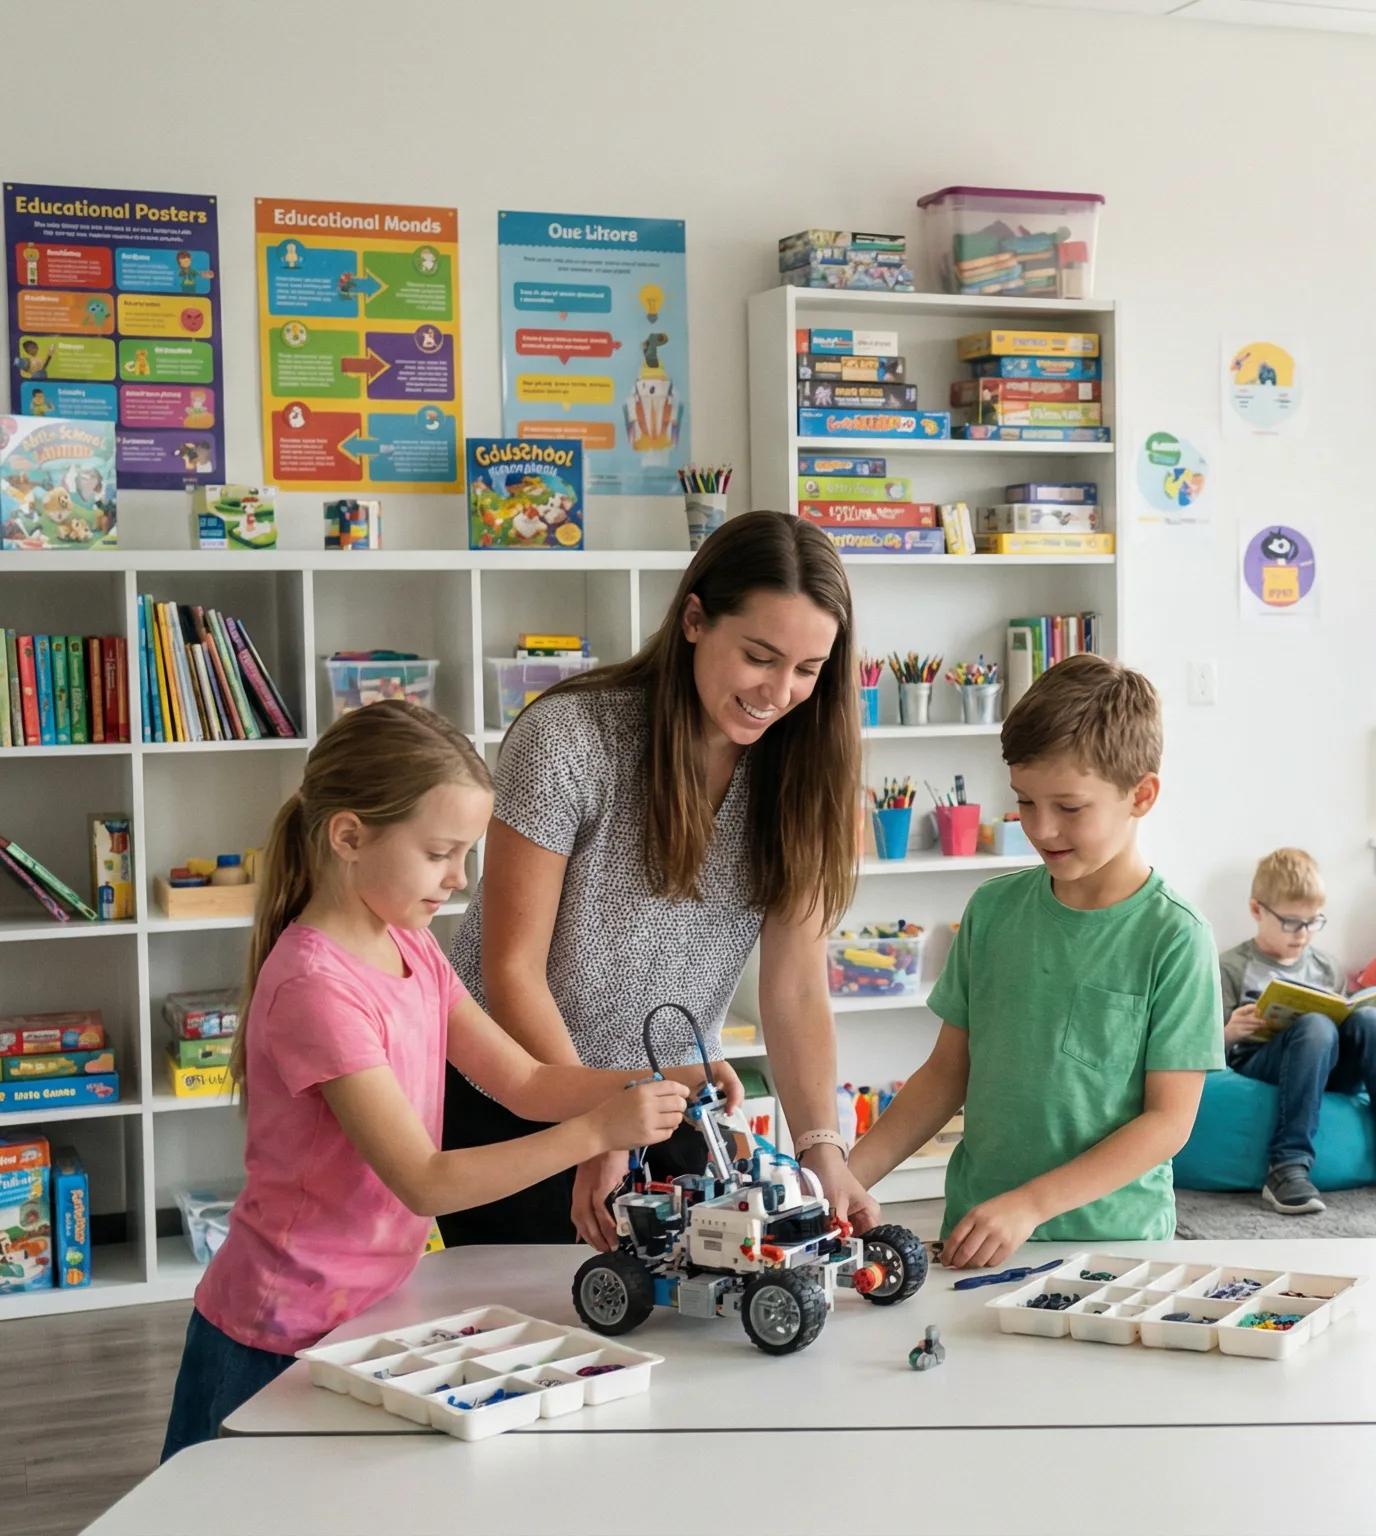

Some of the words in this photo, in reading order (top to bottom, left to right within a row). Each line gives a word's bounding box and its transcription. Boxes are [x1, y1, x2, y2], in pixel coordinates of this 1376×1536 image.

[15, 196, 130, 219] Educational
[135, 203, 207, 224] Posters
[273, 208, 380, 230] Educational
[383, 215, 442, 234] Monds
